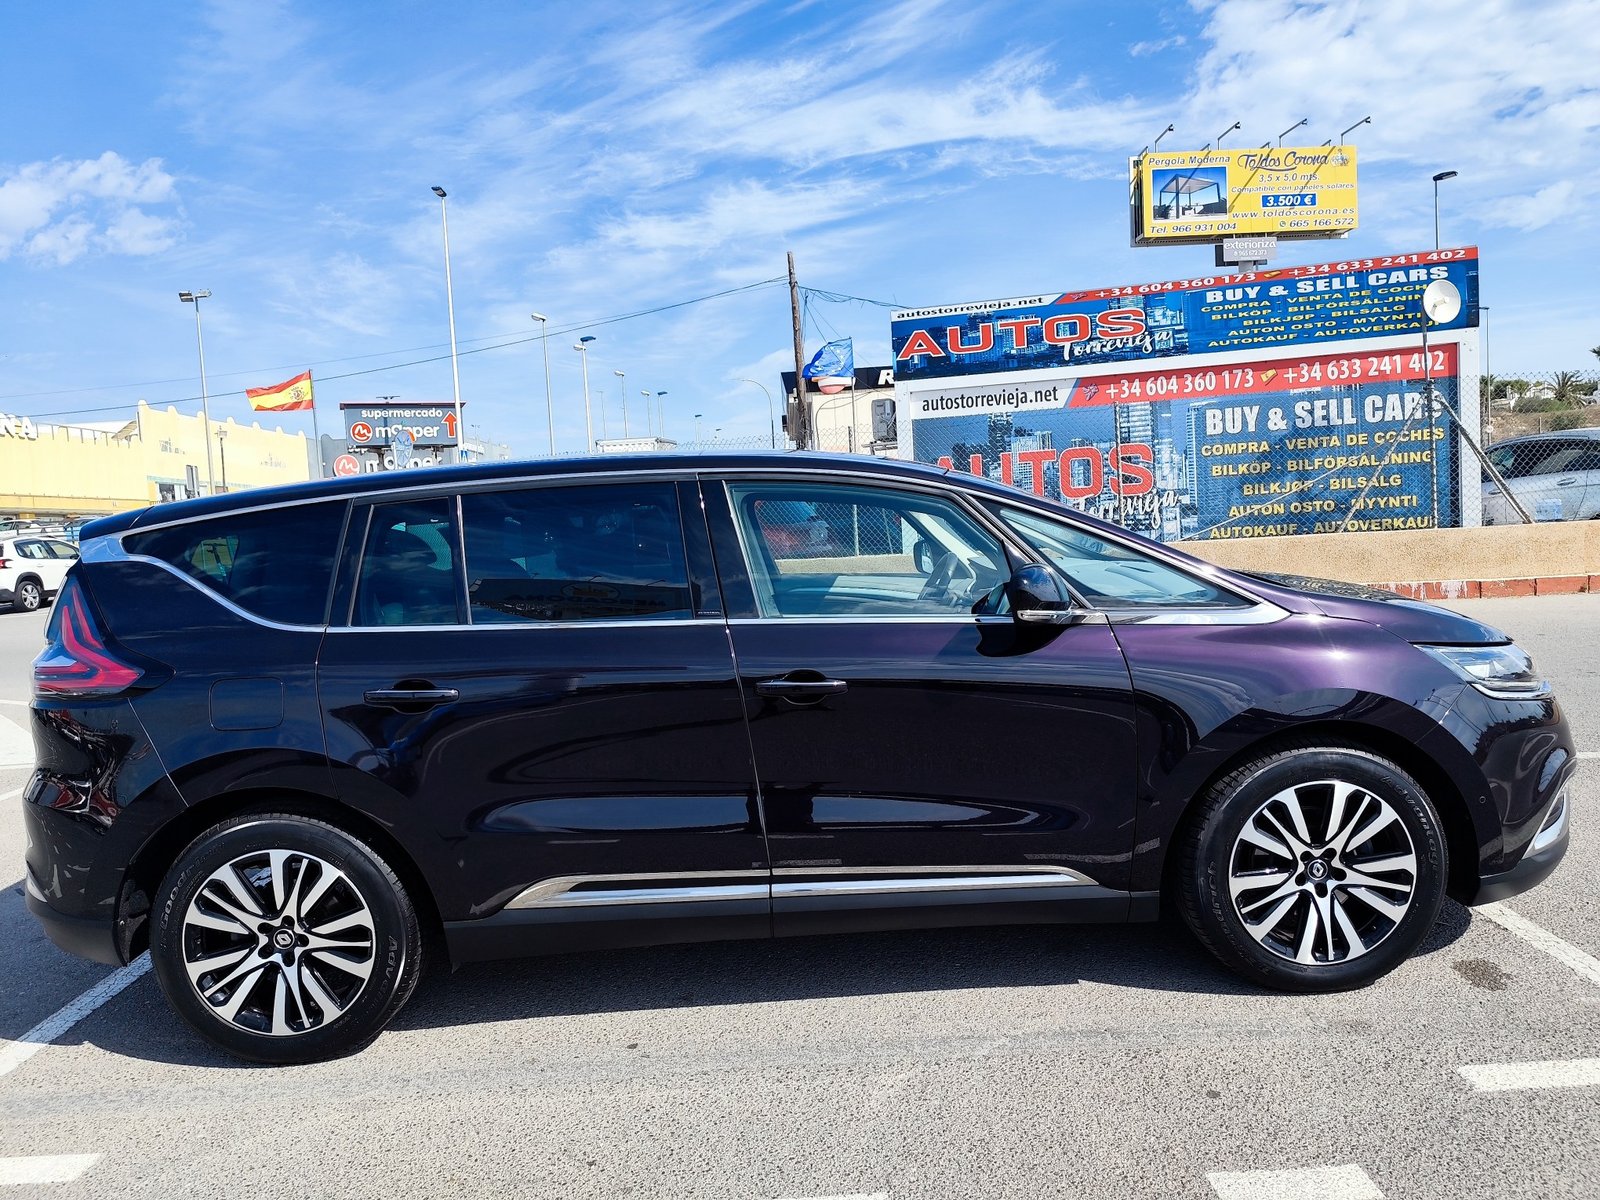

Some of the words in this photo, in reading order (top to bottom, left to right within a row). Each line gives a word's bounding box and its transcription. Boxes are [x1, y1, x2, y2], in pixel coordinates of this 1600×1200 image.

[1148, 157, 1185, 167] Pergola
[1189, 156, 1230, 164] Moderna
[1238, 153, 1281, 170] Toldos
[1284, 151, 1329, 166] Corona
[1231, 184, 1275, 193] Compatible
[1294, 184, 1324, 192] paneles
[1266, 195, 1300, 206] 3.500
[1304, 195, 1313, 205] €
[1232, 208, 1355, 218] www.toldoscorona.es
[1224, 240, 1276, 249] exterioriza
[1095, 286, 1133, 298] +34
[1138, 282, 1173, 293] 604
[1180, 277, 1215, 289] 360
[1221, 272, 1256, 284] 173
[1288, 265, 1330, 276] +34
[1336, 260, 1374, 271] 633
[1381, 255, 1418, 266] 241
[1426, 250, 1466, 261] 402
[1206, 286, 1260, 303] BUY
[1268, 286, 1289, 296] &
[1297, 276, 1359, 293] SELL
[1368, 266, 1449, 286] CARS
[897, 297, 1044, 319] autostorrevieja.net
[1201, 300, 1271, 312] COMPRA
[1287, 293, 1342, 303] VENTA
[1378, 284, 1428, 294] COCH
[1212, 309, 1271, 320] BILKÖP
[1288, 294, 1421, 312] BILFÖRSÄLJNIN
[1228, 326, 1285, 336] AUTON
[1291, 321, 1336, 330] OSTO
[1353, 312, 1422, 324] MYYNTI
[1243, 314, 1314, 326] BILKJØP
[1332, 305, 1405, 317] BILSALG
[896, 308, 1148, 360] AUTOS
[1208, 333, 1298, 347] AUTOKAUF
[1058, 330, 1172, 360] Torrevieja
[1106, 379, 1141, 399] +34
[1146, 375, 1179, 396] 604
[1183, 371, 1216, 393] 360
[1222, 368, 1254, 390] 173
[1283, 362, 1322, 383] +34
[1327, 359, 1362, 380] 633
[1368, 355, 1402, 377] 241
[1409, 350, 1445, 373] 402
[922, 386, 1059, 412] autostorrevieja.net
[361, 408, 442, 419] supermercado
[1205, 405, 1260, 436] BUY
[1268, 408, 1287, 431] &
[1294, 397, 1357, 429] SELL
[1201, 441, 1270, 456] COMPRA
[1286, 435, 1340, 450] VENTA
[1346, 433, 1368, 446] DE
[1374, 427, 1445, 444] COCHES
[1212, 461, 1272, 476] BILKÖP
[1330, 474, 1402, 490] BILSALG
[1229, 504, 1284, 517] AUTON
[1290, 500, 1335, 513] OSTO
[1210, 524, 1297, 539] AUTOKAUF
